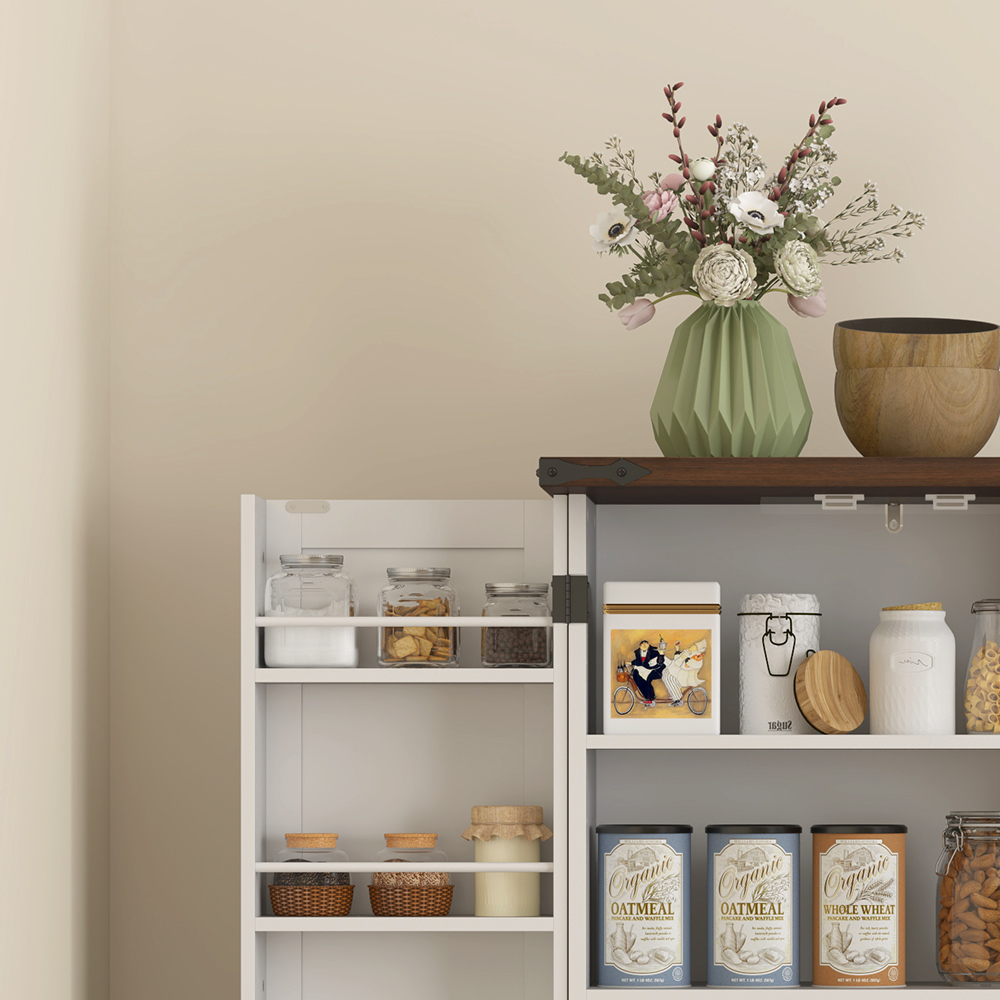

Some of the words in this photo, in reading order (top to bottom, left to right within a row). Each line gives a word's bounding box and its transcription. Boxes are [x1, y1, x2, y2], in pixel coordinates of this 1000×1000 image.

[609, 855, 674, 900] Organic
[719, 855, 783, 900] Organic
[824, 855, 889, 900] Organic
[611, 902, 674, 915] OATMEAL
[721, 902, 784, 915] OATMEAL
[823, 905, 858, 915] WHOLE
[861, 905, 895, 915] WHEAT
